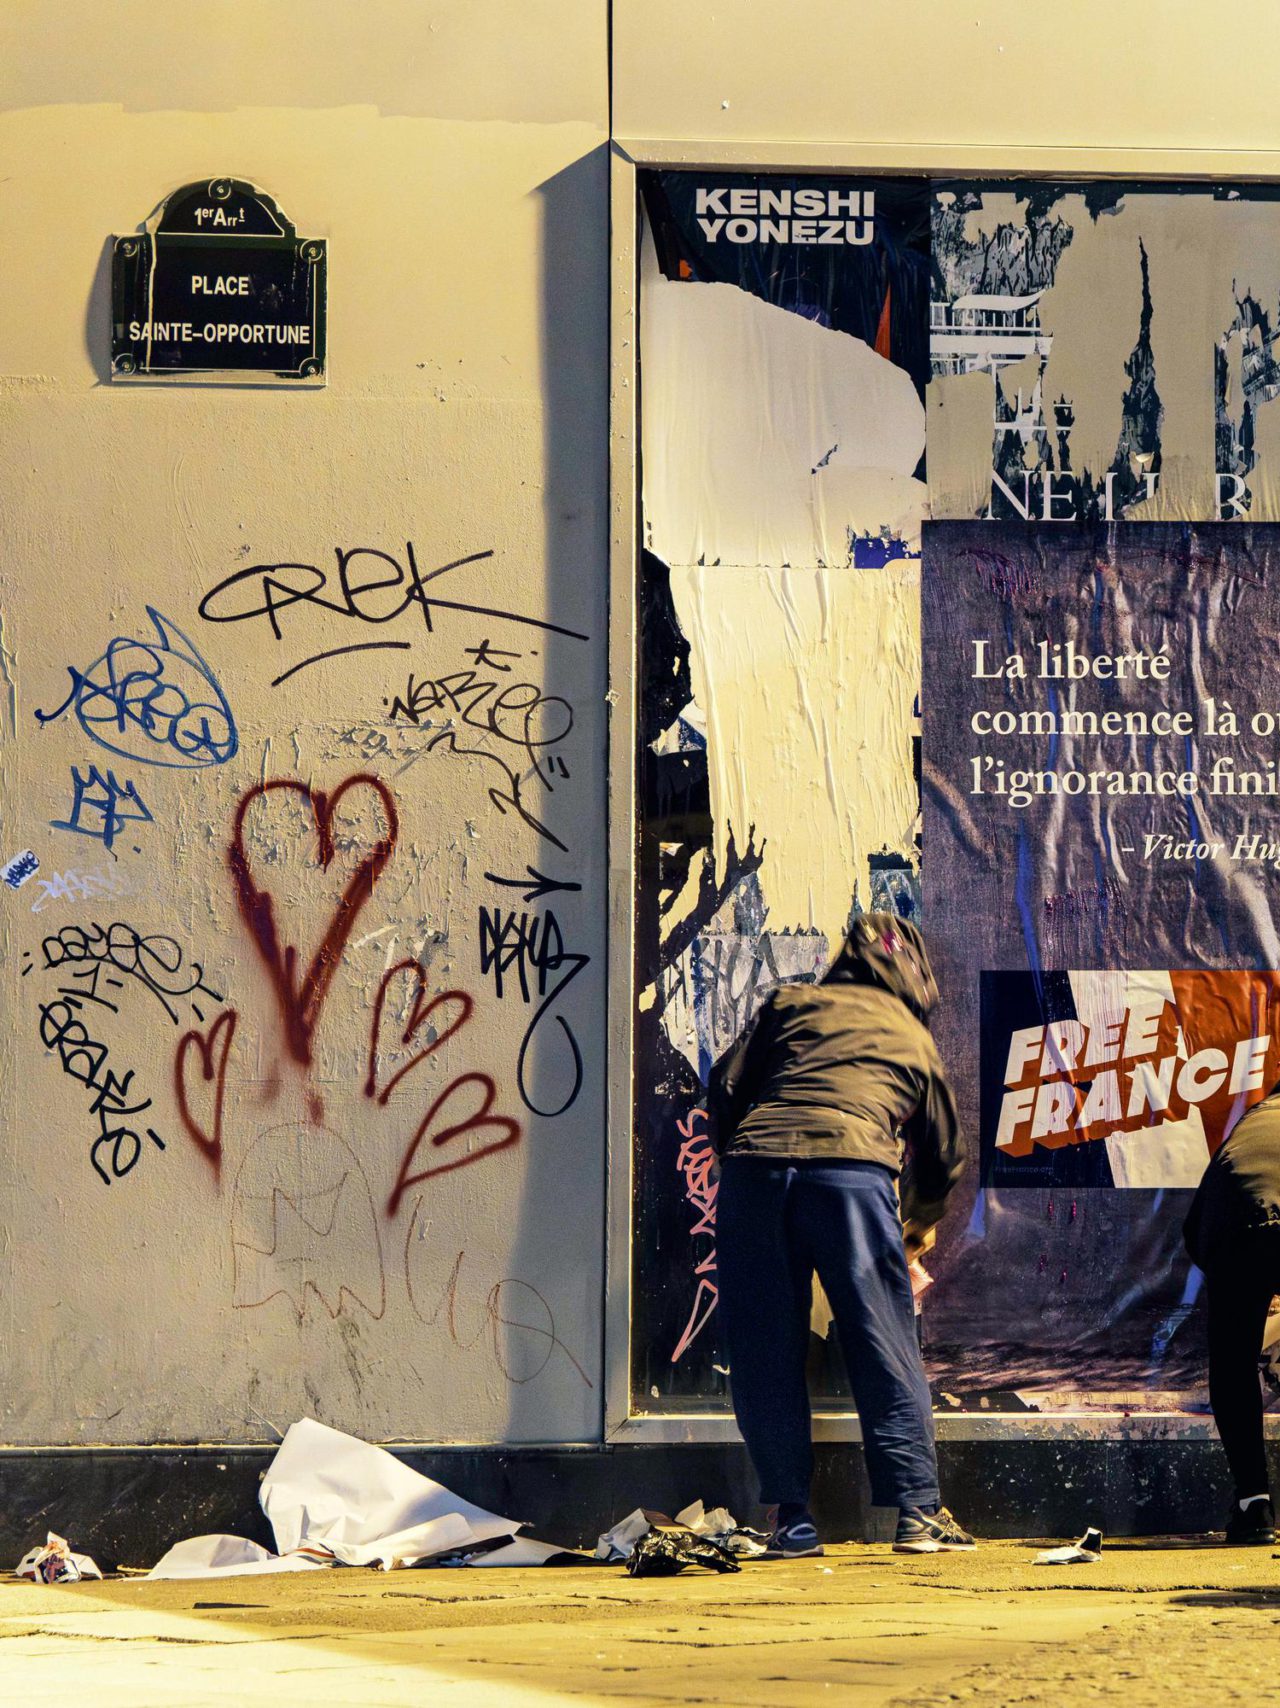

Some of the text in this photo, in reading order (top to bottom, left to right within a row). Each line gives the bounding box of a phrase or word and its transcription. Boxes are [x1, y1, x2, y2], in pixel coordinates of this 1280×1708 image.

[695, 188, 875, 217] KENSHI
[697, 218, 874, 246] YONEZU
[191, 275, 249, 296] PLACE
[129, 321, 310, 344] SAINTE-OPPORTUNE
[971, 640, 1171, 680] La liberté
[971, 709, 1193, 736] commence
[1204, 698, 1240, 736] là
[1143, 834, 1225, 861] Victor
[1003, 1000, 1166, 1089] FREE
[995, 1035, 1271, 1155] FRANCE
